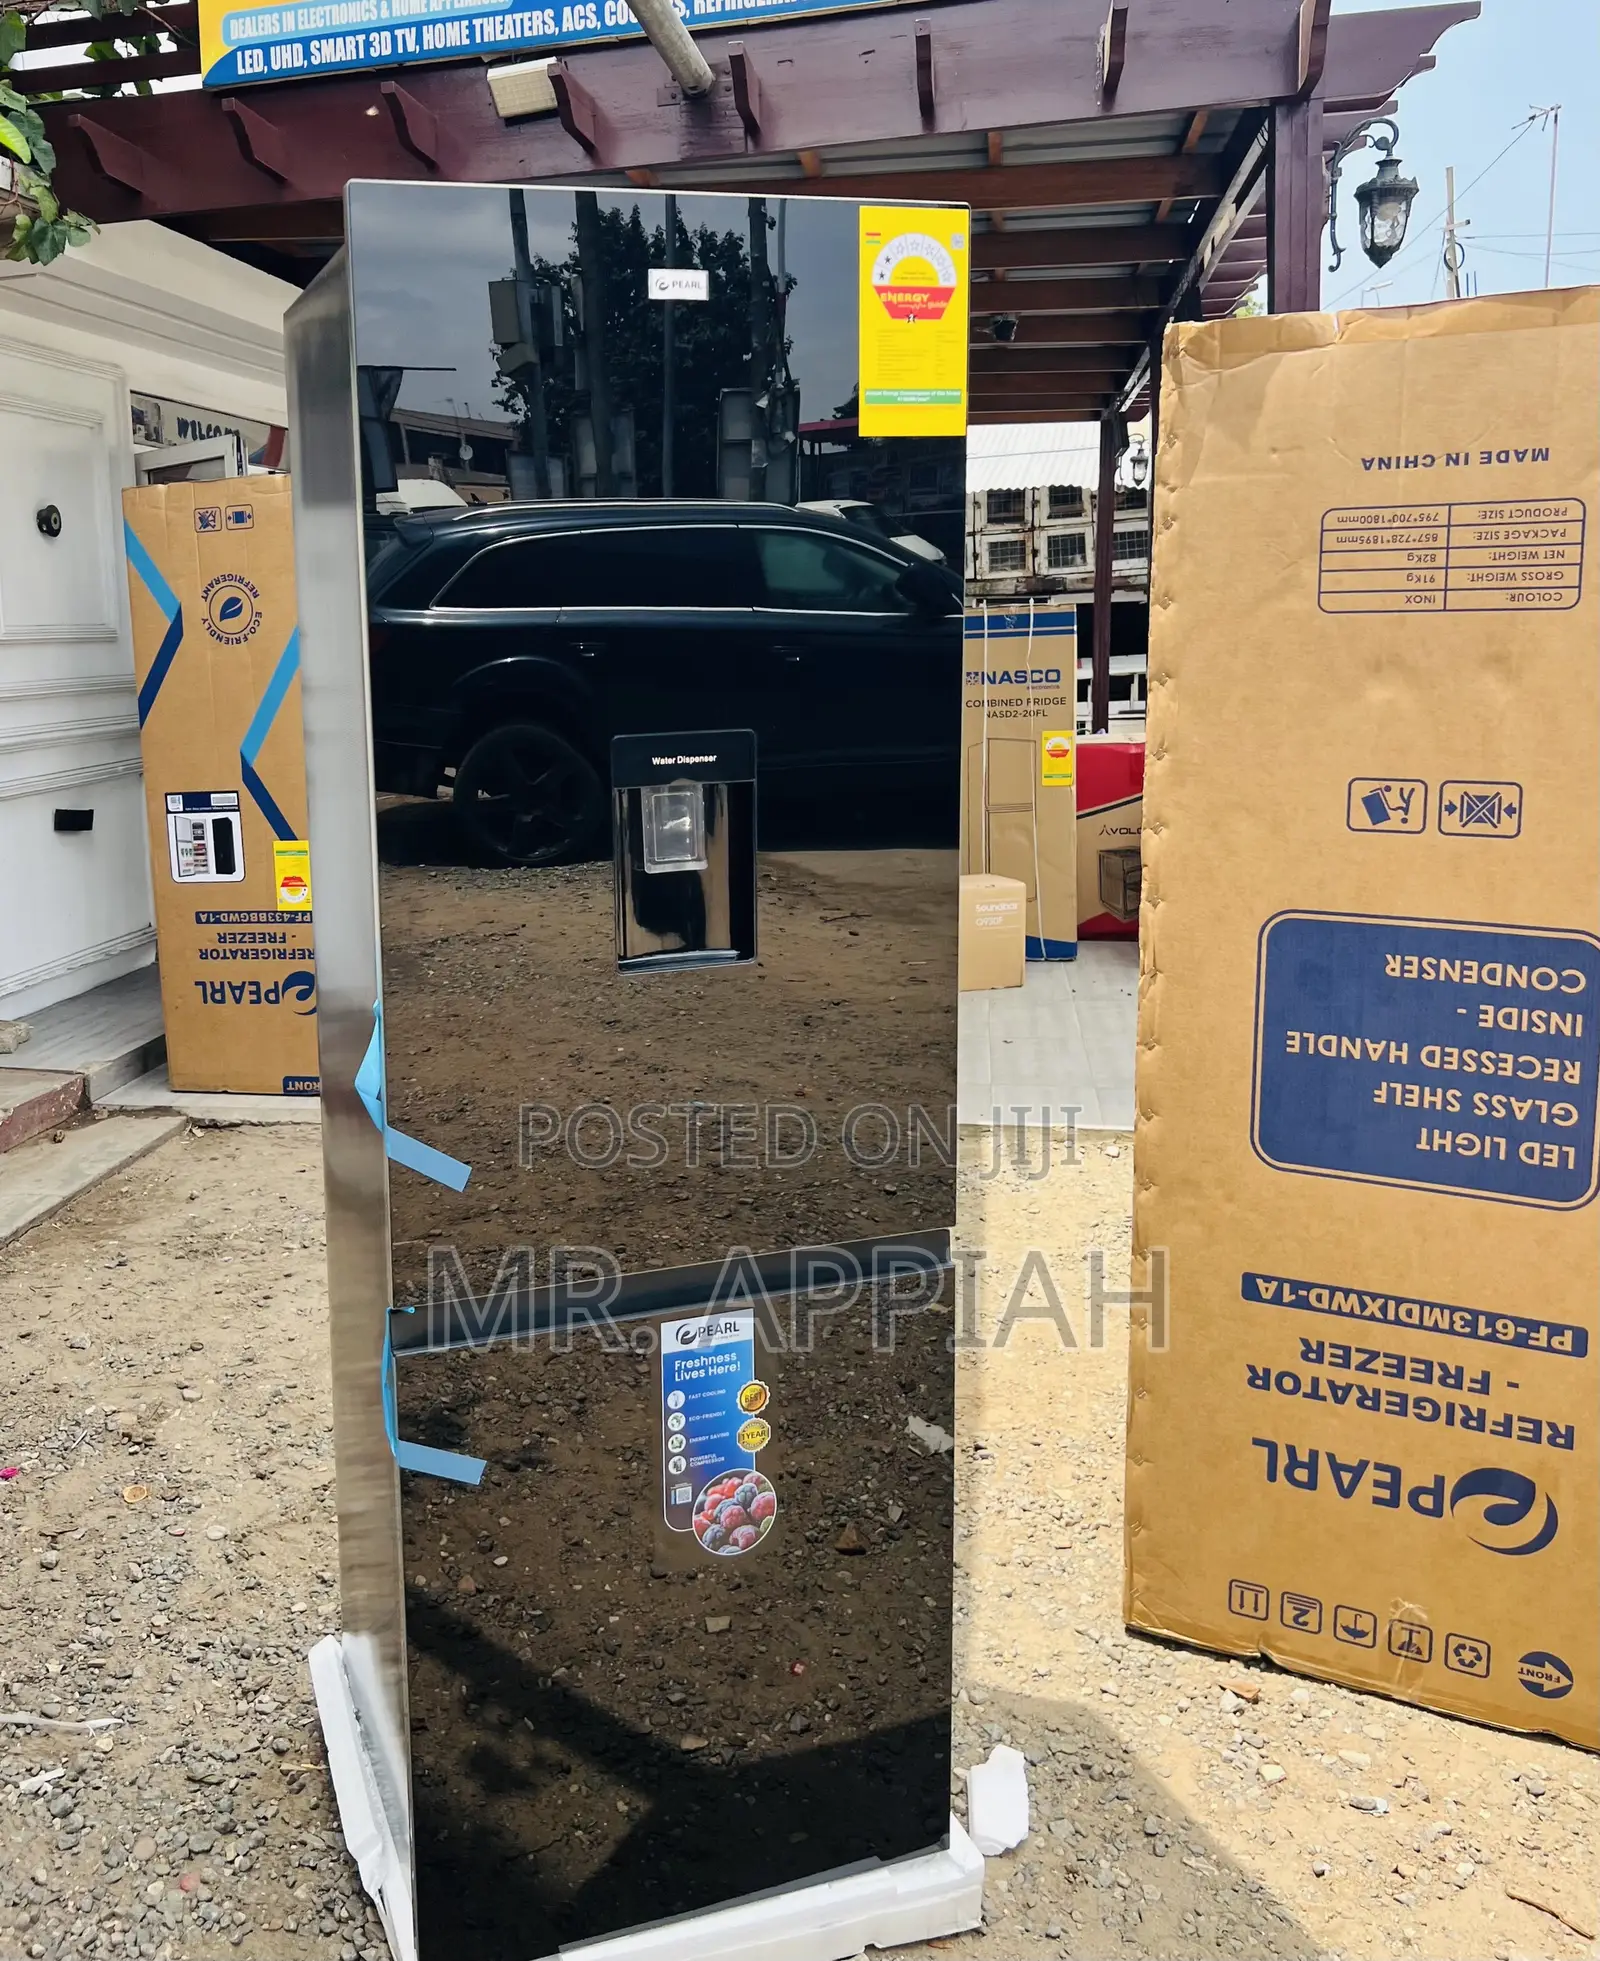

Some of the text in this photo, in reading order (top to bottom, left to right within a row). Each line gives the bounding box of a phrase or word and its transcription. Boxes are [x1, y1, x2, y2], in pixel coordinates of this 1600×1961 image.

[230, 12, 281, 40] DEALERS
[283, 11, 295, 33] IN
[297, 1, 378, 30] ELECTRONICS
[381, 1, 390, 18] &
[236, 49, 268, 75] LED,
[270, 43, 308, 71] UHD,
[310, 34, 366, 66] SMART
[369, 31, 391, 58] 3D
[395, 27, 420, 54] TV,
[422, 20, 469, 50] HOME
[473, 9, 560, 46] THEATERS,
[562, 3, 601, 33] ACS,
[672, 280, 702, 289] PEARL
[1361, 447, 1550, 471] MADE IN CHINA
[1478, 509, 1505, 519] SIZE:
[1508, 507, 1568, 518] PRODUCT
[1473, 531, 1500, 541] SIZE:
[1504, 528, 1567, 540] PACKAGE
[1407, 549, 1566, 563] NET WEIGHT: 82Kg
[1406, 571, 1564, 584] GROSS WEIGHT: 91Kg
[201, 573, 260, 602] REFRIGERANT
[1405, 591, 1563, 605] COLOUR: INOX
[201, 611, 263, 645] ECO-FRIENDLY
[981, 669, 1061, 685] NASCO
[966, 696, 1067, 708] COMBINED FRIDGE
[652, 755, 717, 765] Water Dispenser
[199, 912, 311, 923] PF-433BBGWD-1A
[216, 932, 287, 944] FREEZER
[198, 948, 315, 961] REFRIGERATOR
[1384, 953, 1587, 994] CONDENSER
[194, 980, 281, 1005] PEARL
[1478, 1004, 1583, 1038] INSIDE
[1286, 1030, 1581, 1084] RECESSED HANDLE
[287, 1080, 320, 1091] RONT
[1373, 1081, 1579, 1127] GLASS SHELF
[1416, 1127, 1576, 1170] LED LIGHT
[1255, 1277, 1574, 1352] PF-613MDIXWD-1A
[698, 1320, 740, 1338] PEARL
[675, 1352, 737, 1371] Freshness
[1299, 1336, 1491, 1396] FREEZER
[675, 1361, 741, 1382] Lives Here!
[688, 1392, 702, 1400] FAST
[1245, 1363, 1575, 1451] REFRIGERATOR
[688, 1410, 726, 1422] ECO-FRIENDLY
[746, 1429, 767, 1440] YEAR
[1252, 1436, 1446, 1519] PEARL
[1517, 1667, 1561, 1684] FRONT
